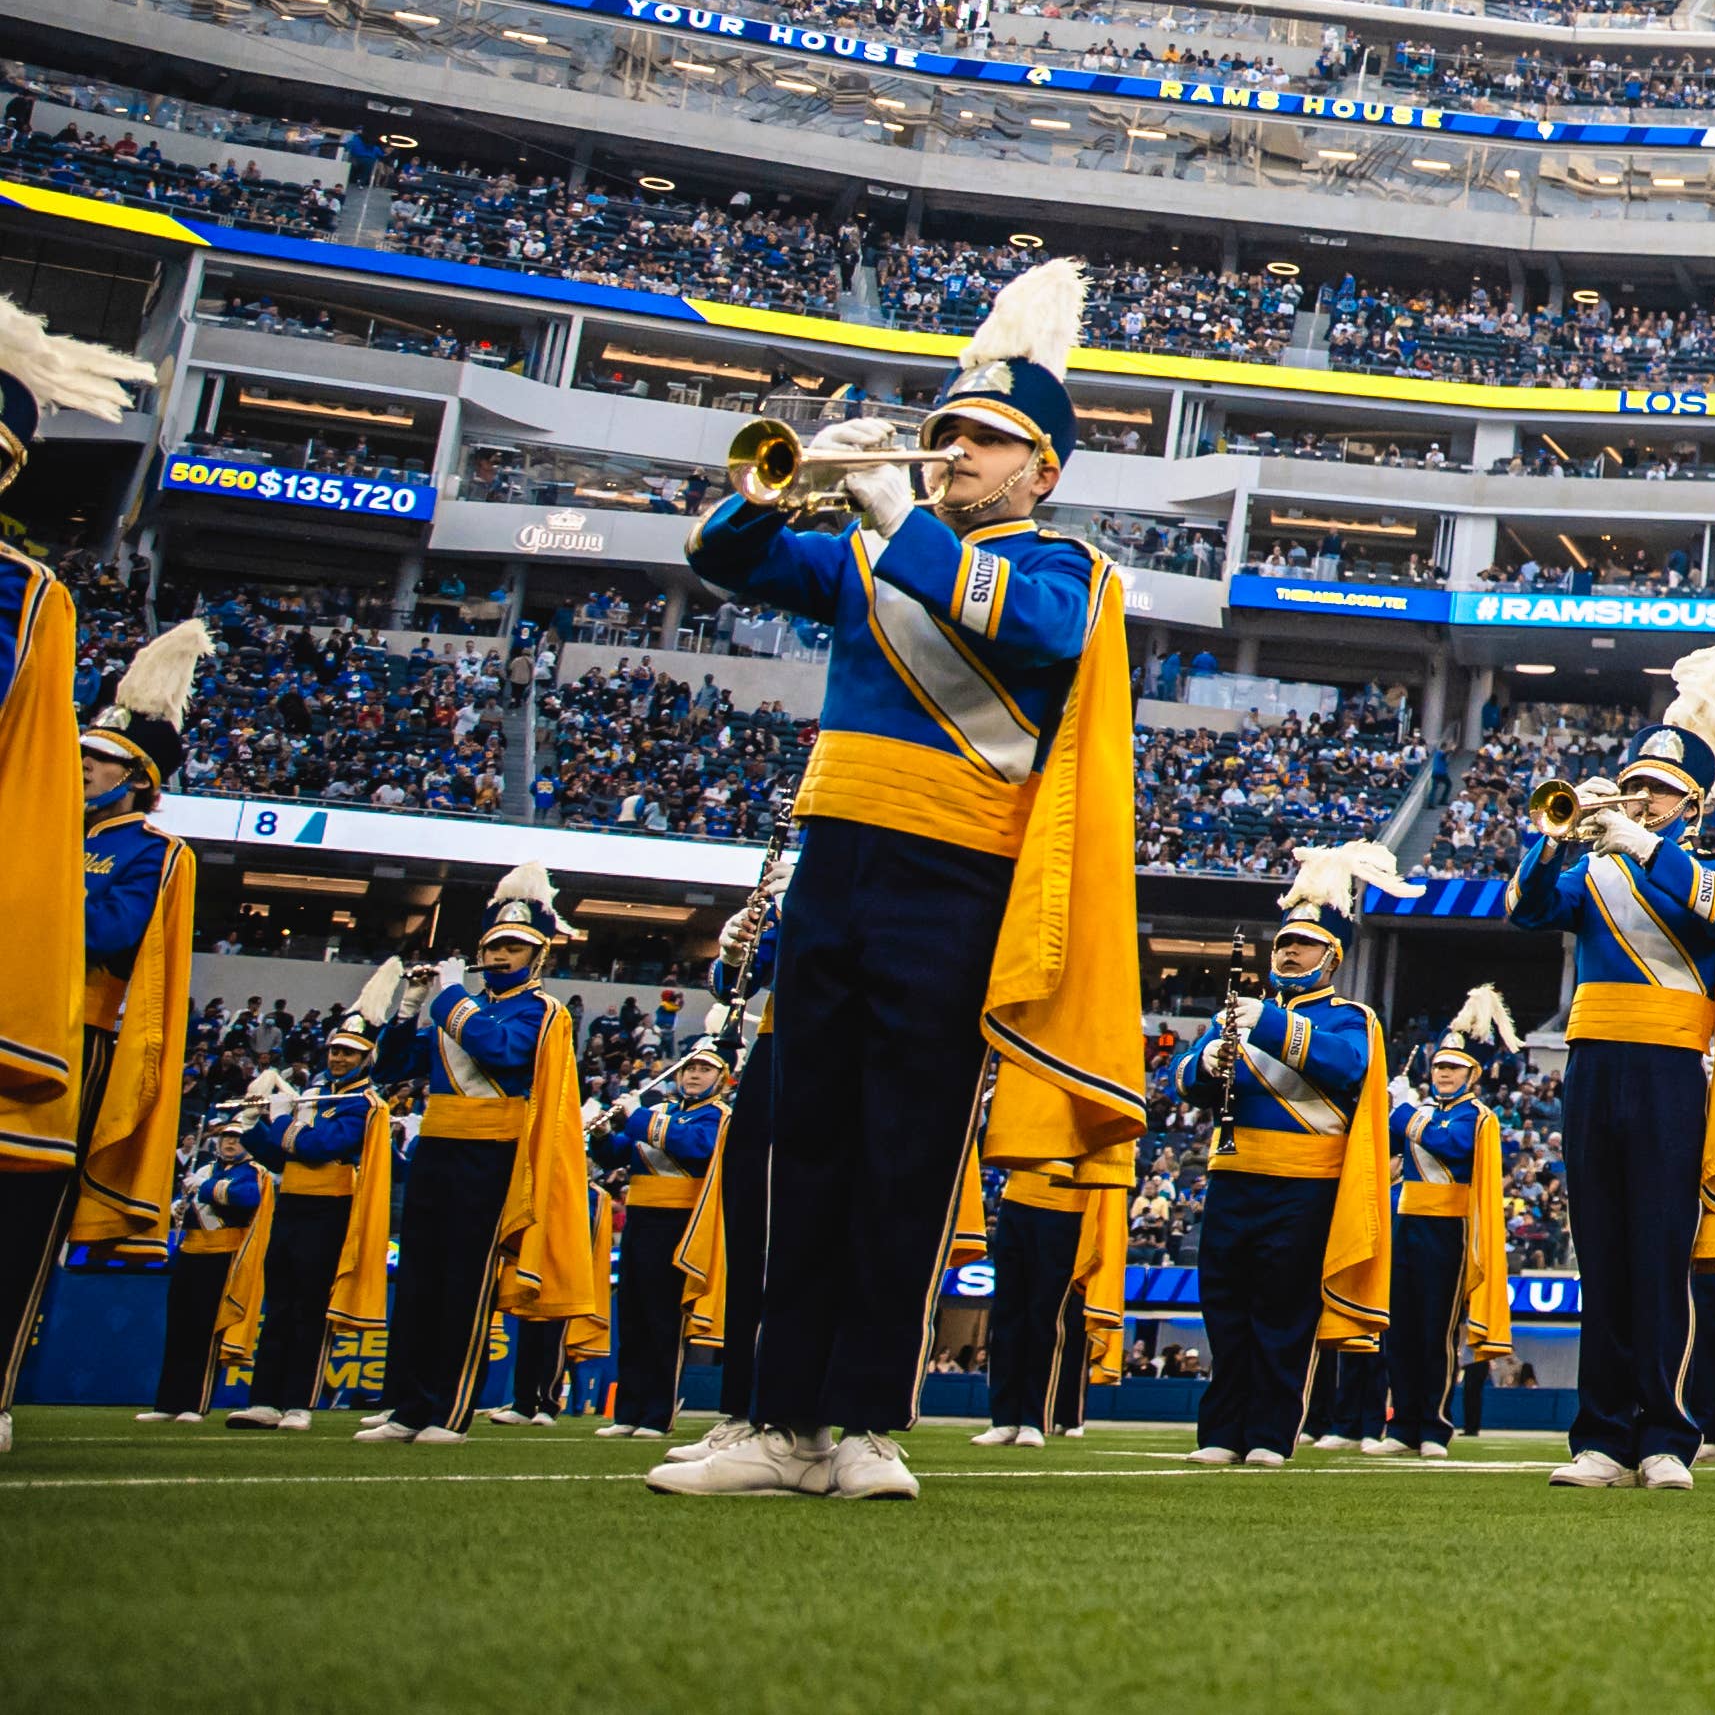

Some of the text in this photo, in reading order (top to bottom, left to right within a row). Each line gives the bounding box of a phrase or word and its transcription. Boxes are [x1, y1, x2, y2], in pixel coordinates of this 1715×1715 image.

[769, 26, 919, 69] HOUSE
[1160, 79, 1443, 128] RAMS HOUSE
[1618, 391, 1707, 416] LOS
[169, 462, 416, 513] 50/50 $135,720
[515, 525, 604, 553] Corona
[255, 811, 278, 836] 8
